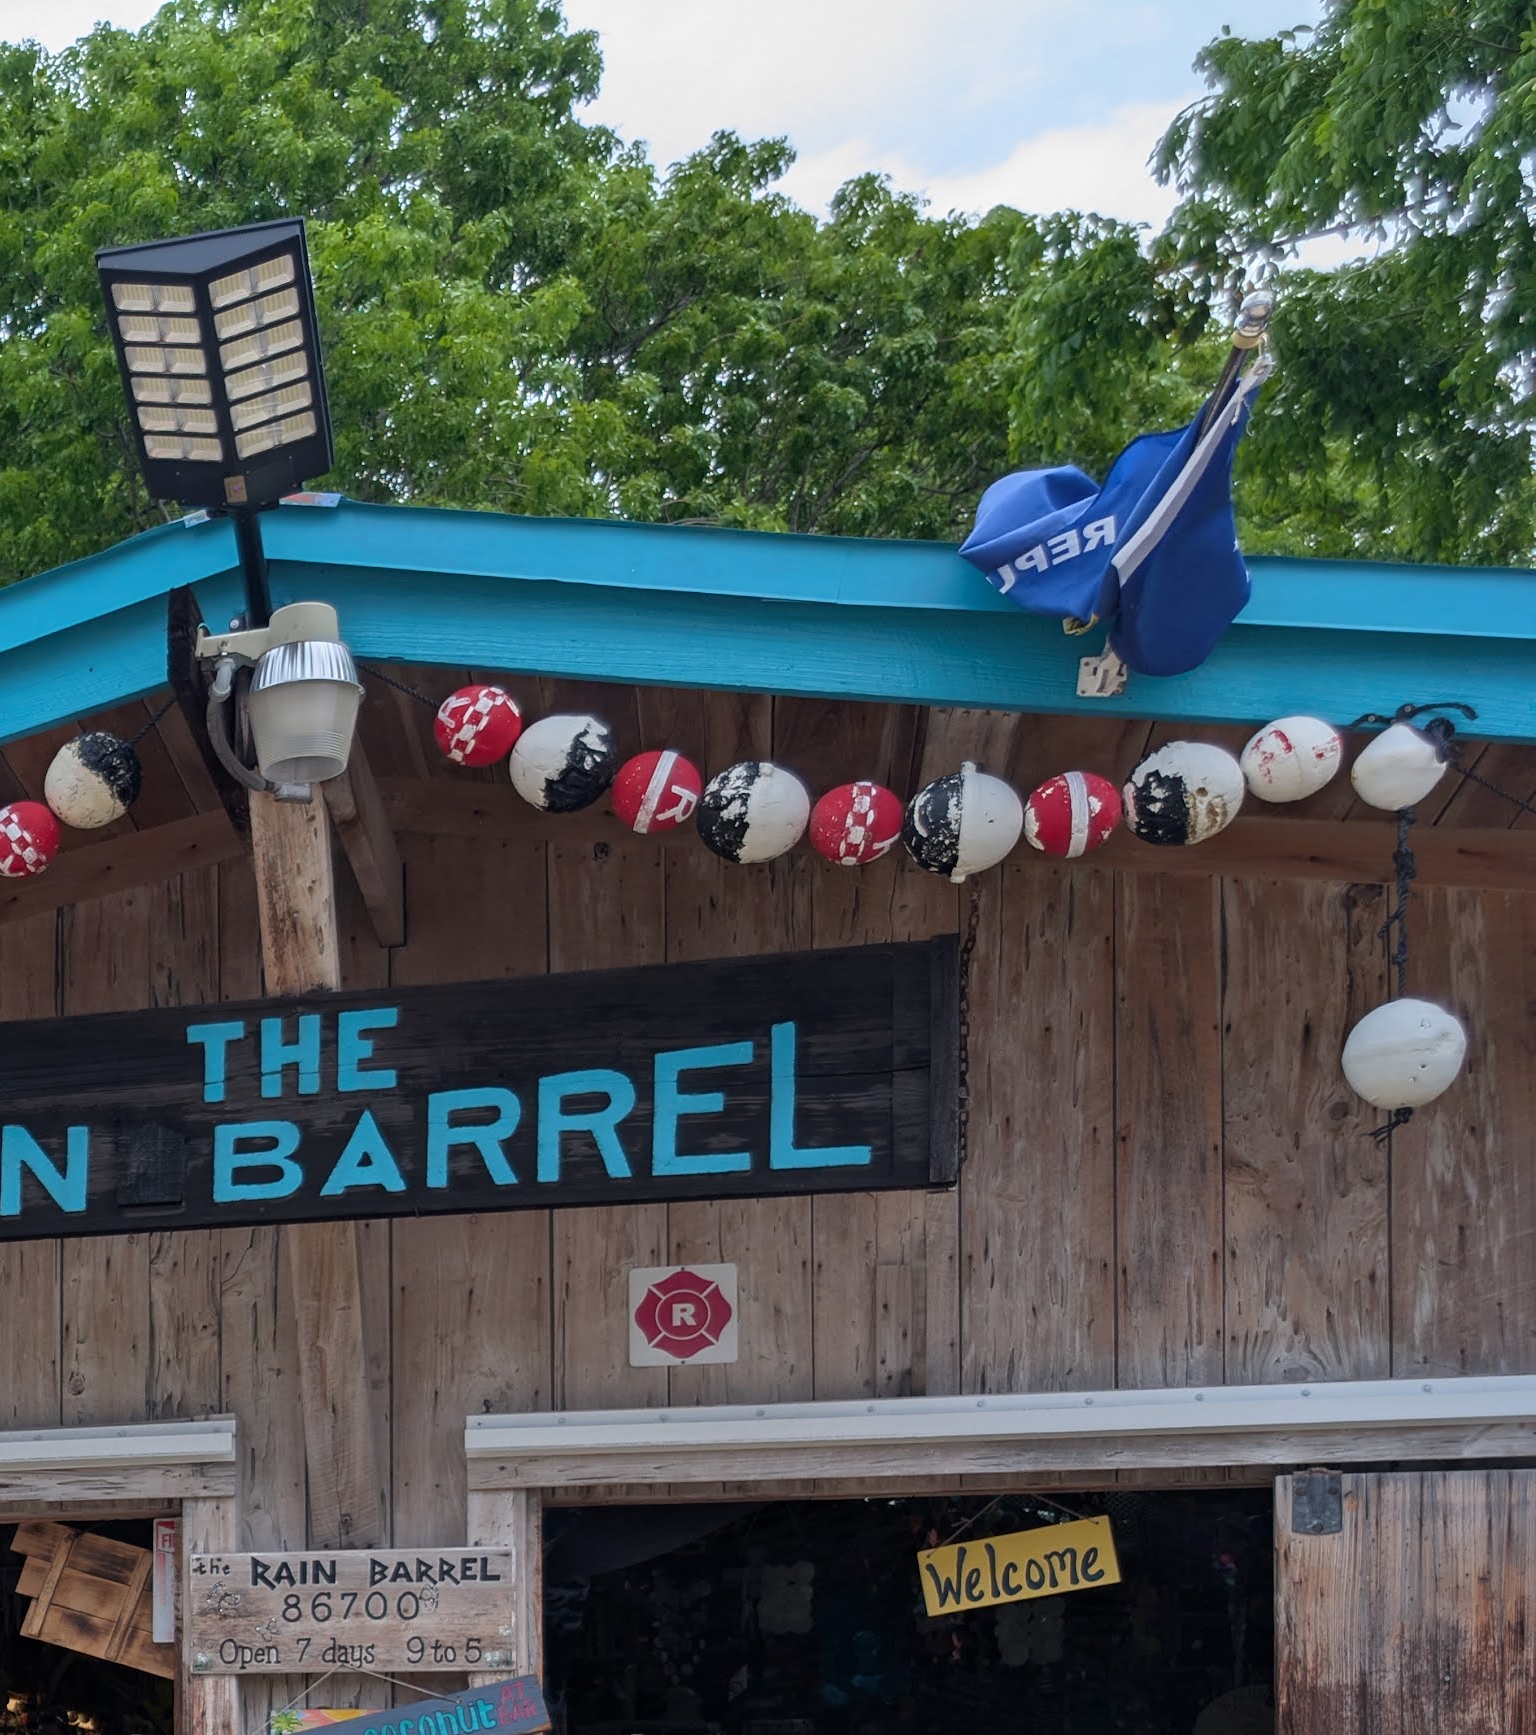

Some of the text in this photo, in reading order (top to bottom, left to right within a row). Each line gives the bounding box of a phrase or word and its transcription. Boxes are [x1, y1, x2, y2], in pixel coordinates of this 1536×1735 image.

[187, 1007, 400, 1102] THE
[213, 1020, 872, 1202] BARREL
[672, 1303, 696, 1326] R
[193, 1556, 501, 1590] the RAIN BARREL
[925, 1542, 1105, 1608] Welcome
[281, 1591, 420, 1622] 86700
[219, 1636, 483, 1670] Open 7 days 9 to 5
[500, 1680, 525, 1704] AT
[497, 1698, 538, 1726] BAR
